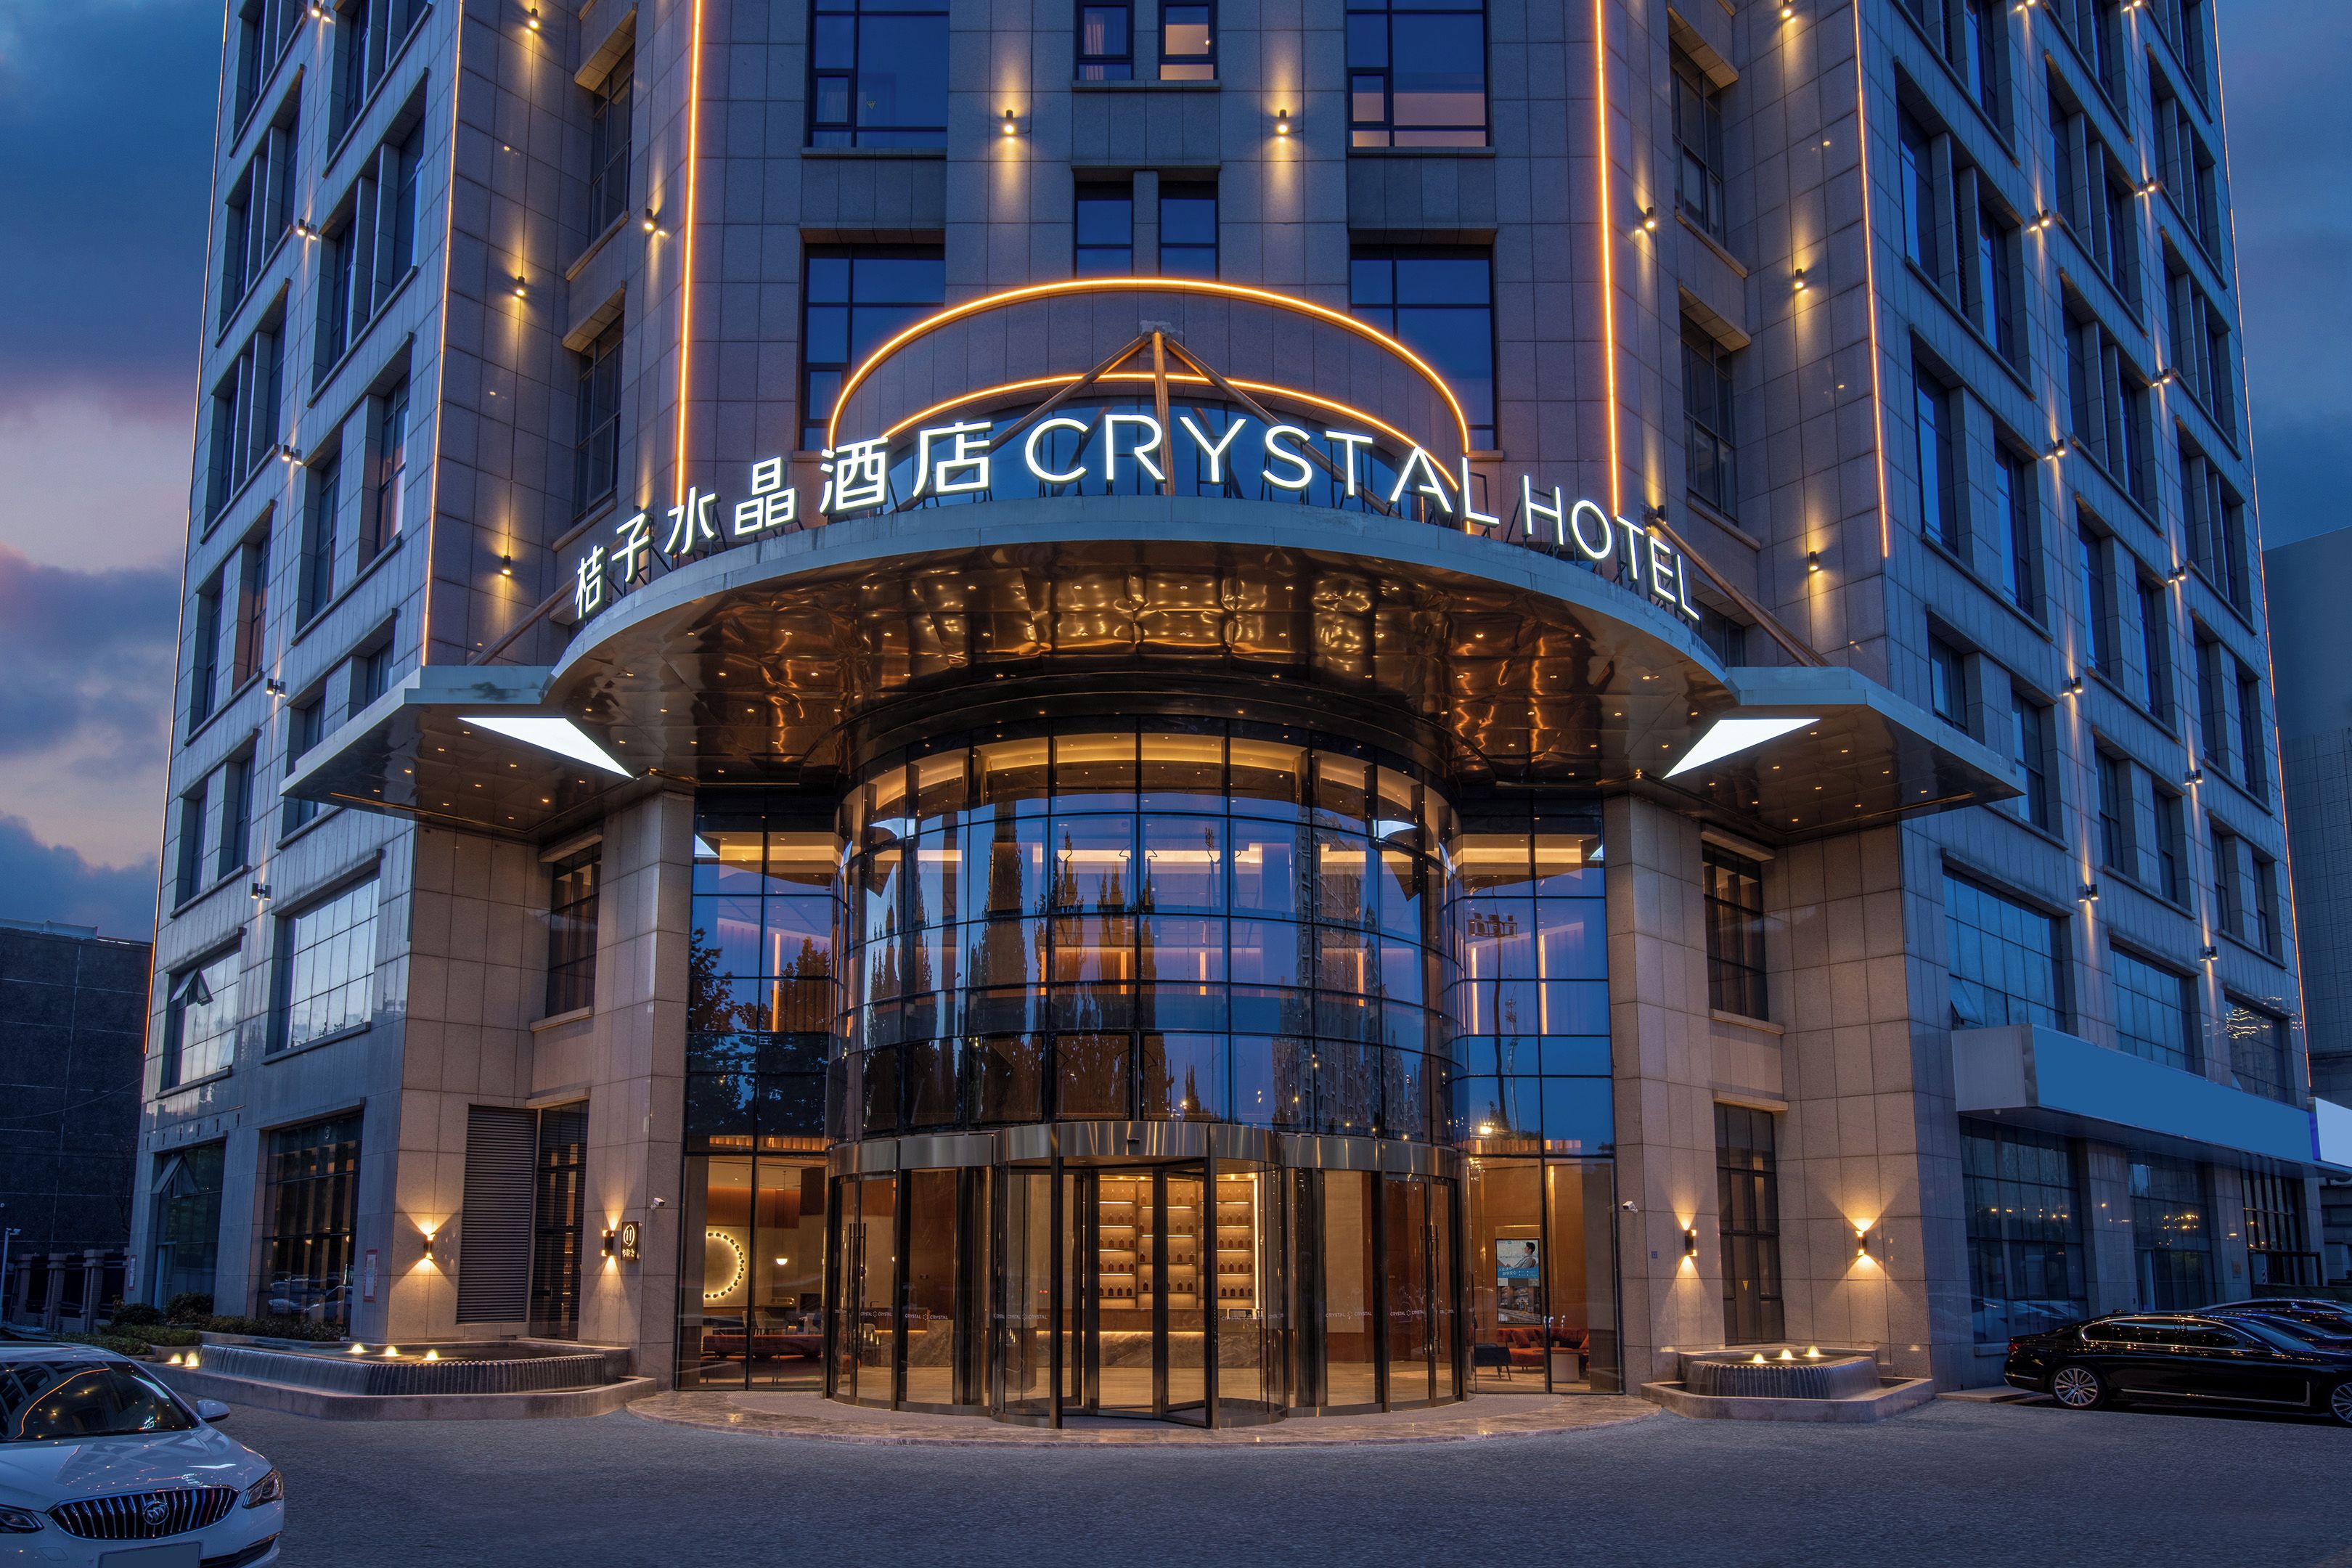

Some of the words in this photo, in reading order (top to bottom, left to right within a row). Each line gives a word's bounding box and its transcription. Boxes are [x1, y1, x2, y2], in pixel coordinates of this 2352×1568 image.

[575, 422, 993, 619] 桔子水晶酒店
[1024, 414, 1501, 527] CRYSTAL
[1520, 474, 1700, 621] HOTEL
